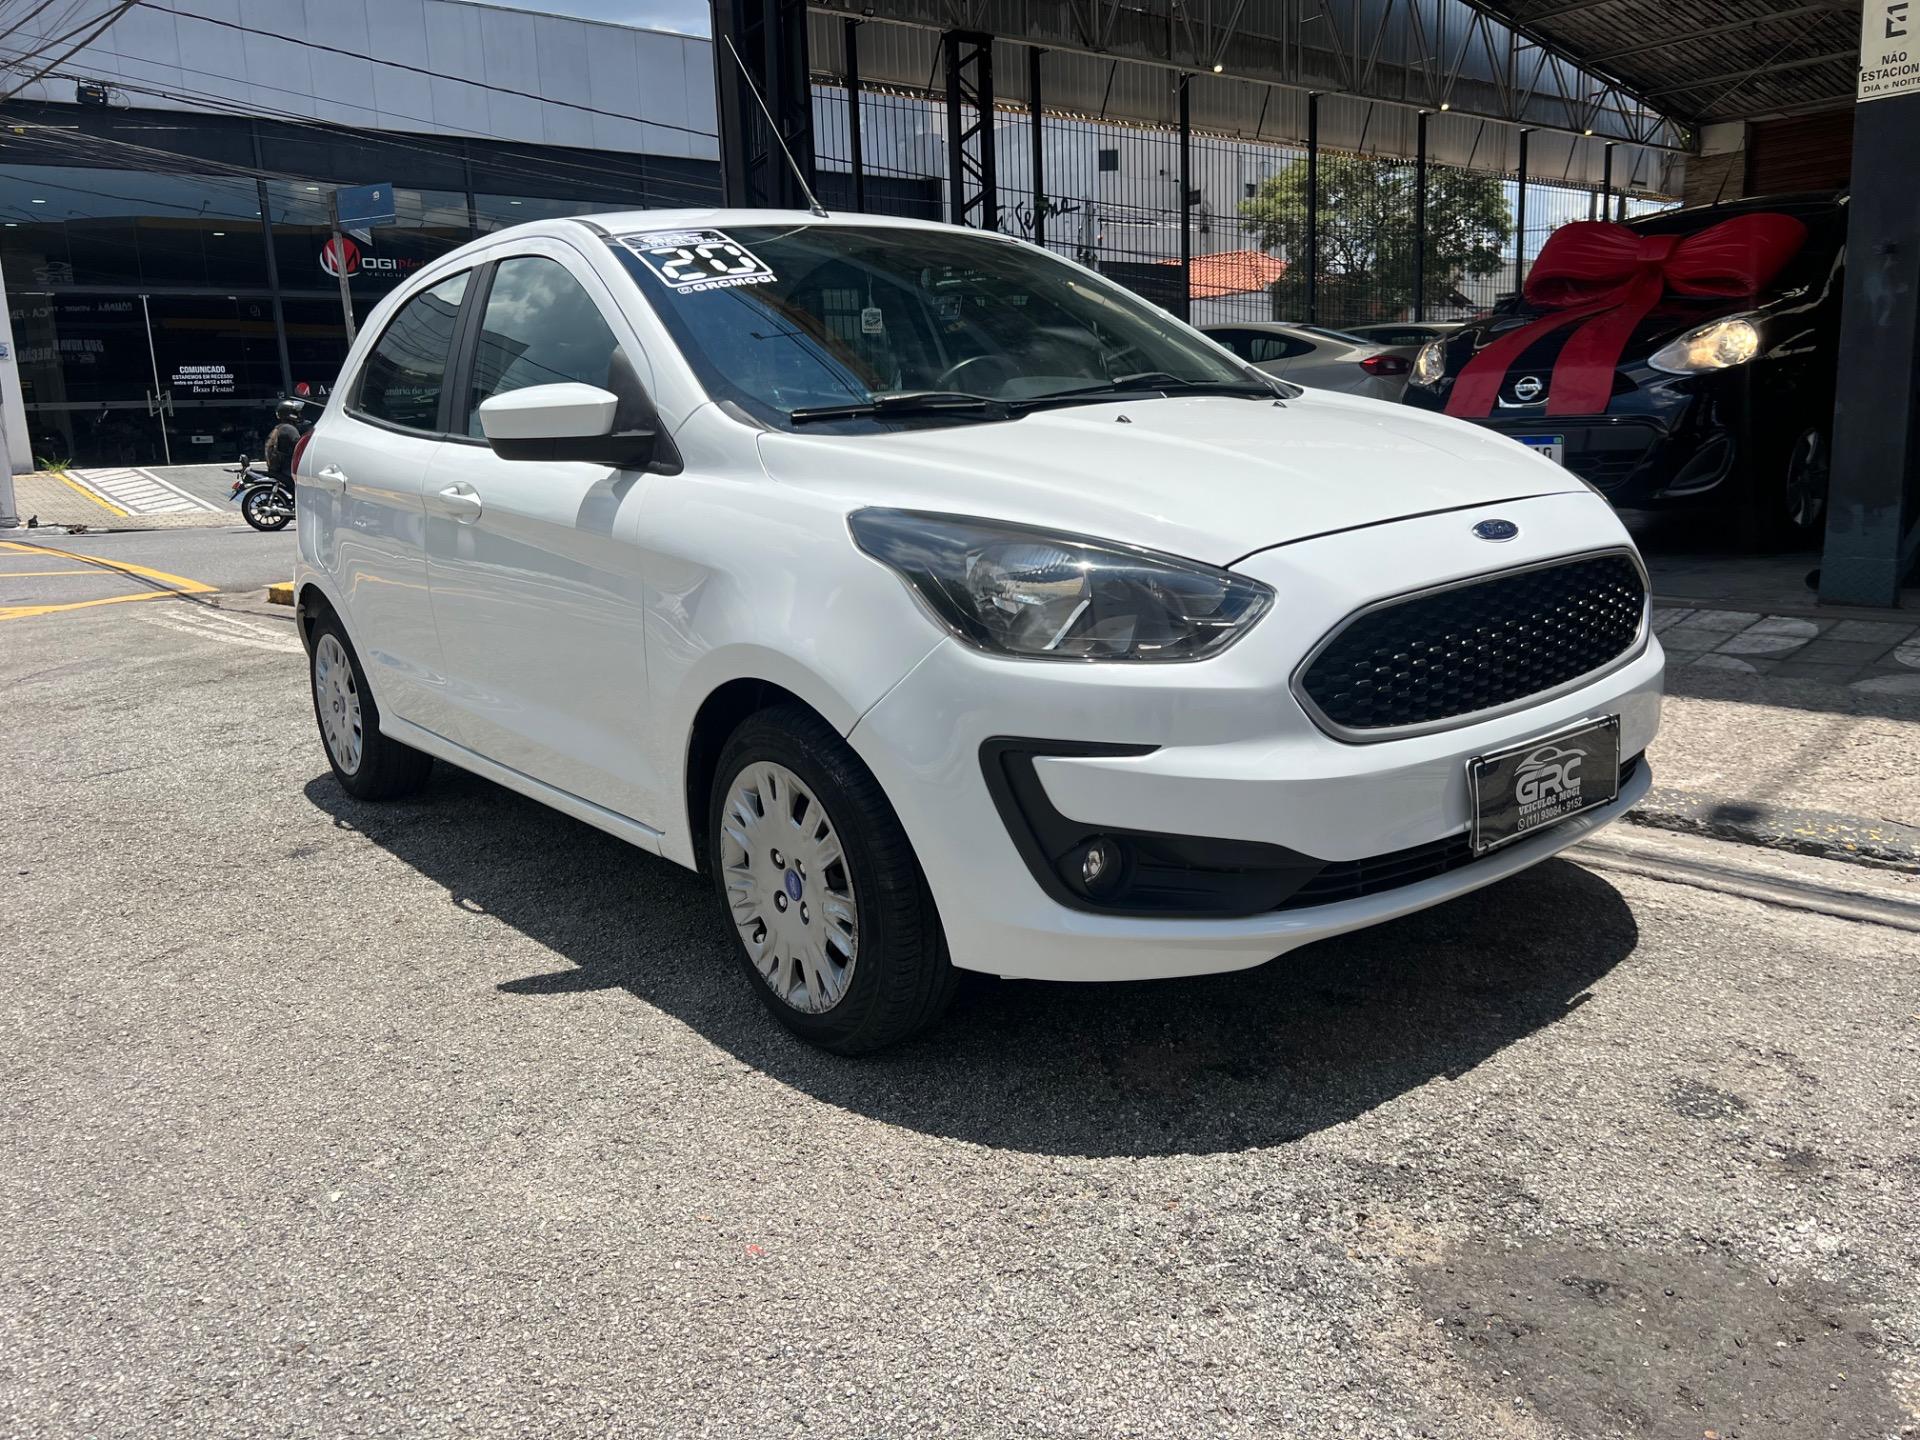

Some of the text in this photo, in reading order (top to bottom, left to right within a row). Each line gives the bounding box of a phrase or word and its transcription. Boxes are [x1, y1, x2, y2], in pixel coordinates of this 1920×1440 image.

[1881, 51, 1908, 65] NÃO
[1861, 63, 1920, 82] ESTACION
[1863, 84, 1881, 93] DIA
[650, 243, 758, 281] 20
[180, 366, 226, 374] COMUNICADO
[1516, 757, 1582, 804] GRC
[1518, 785, 1580, 815] VEICULOS MOGI
